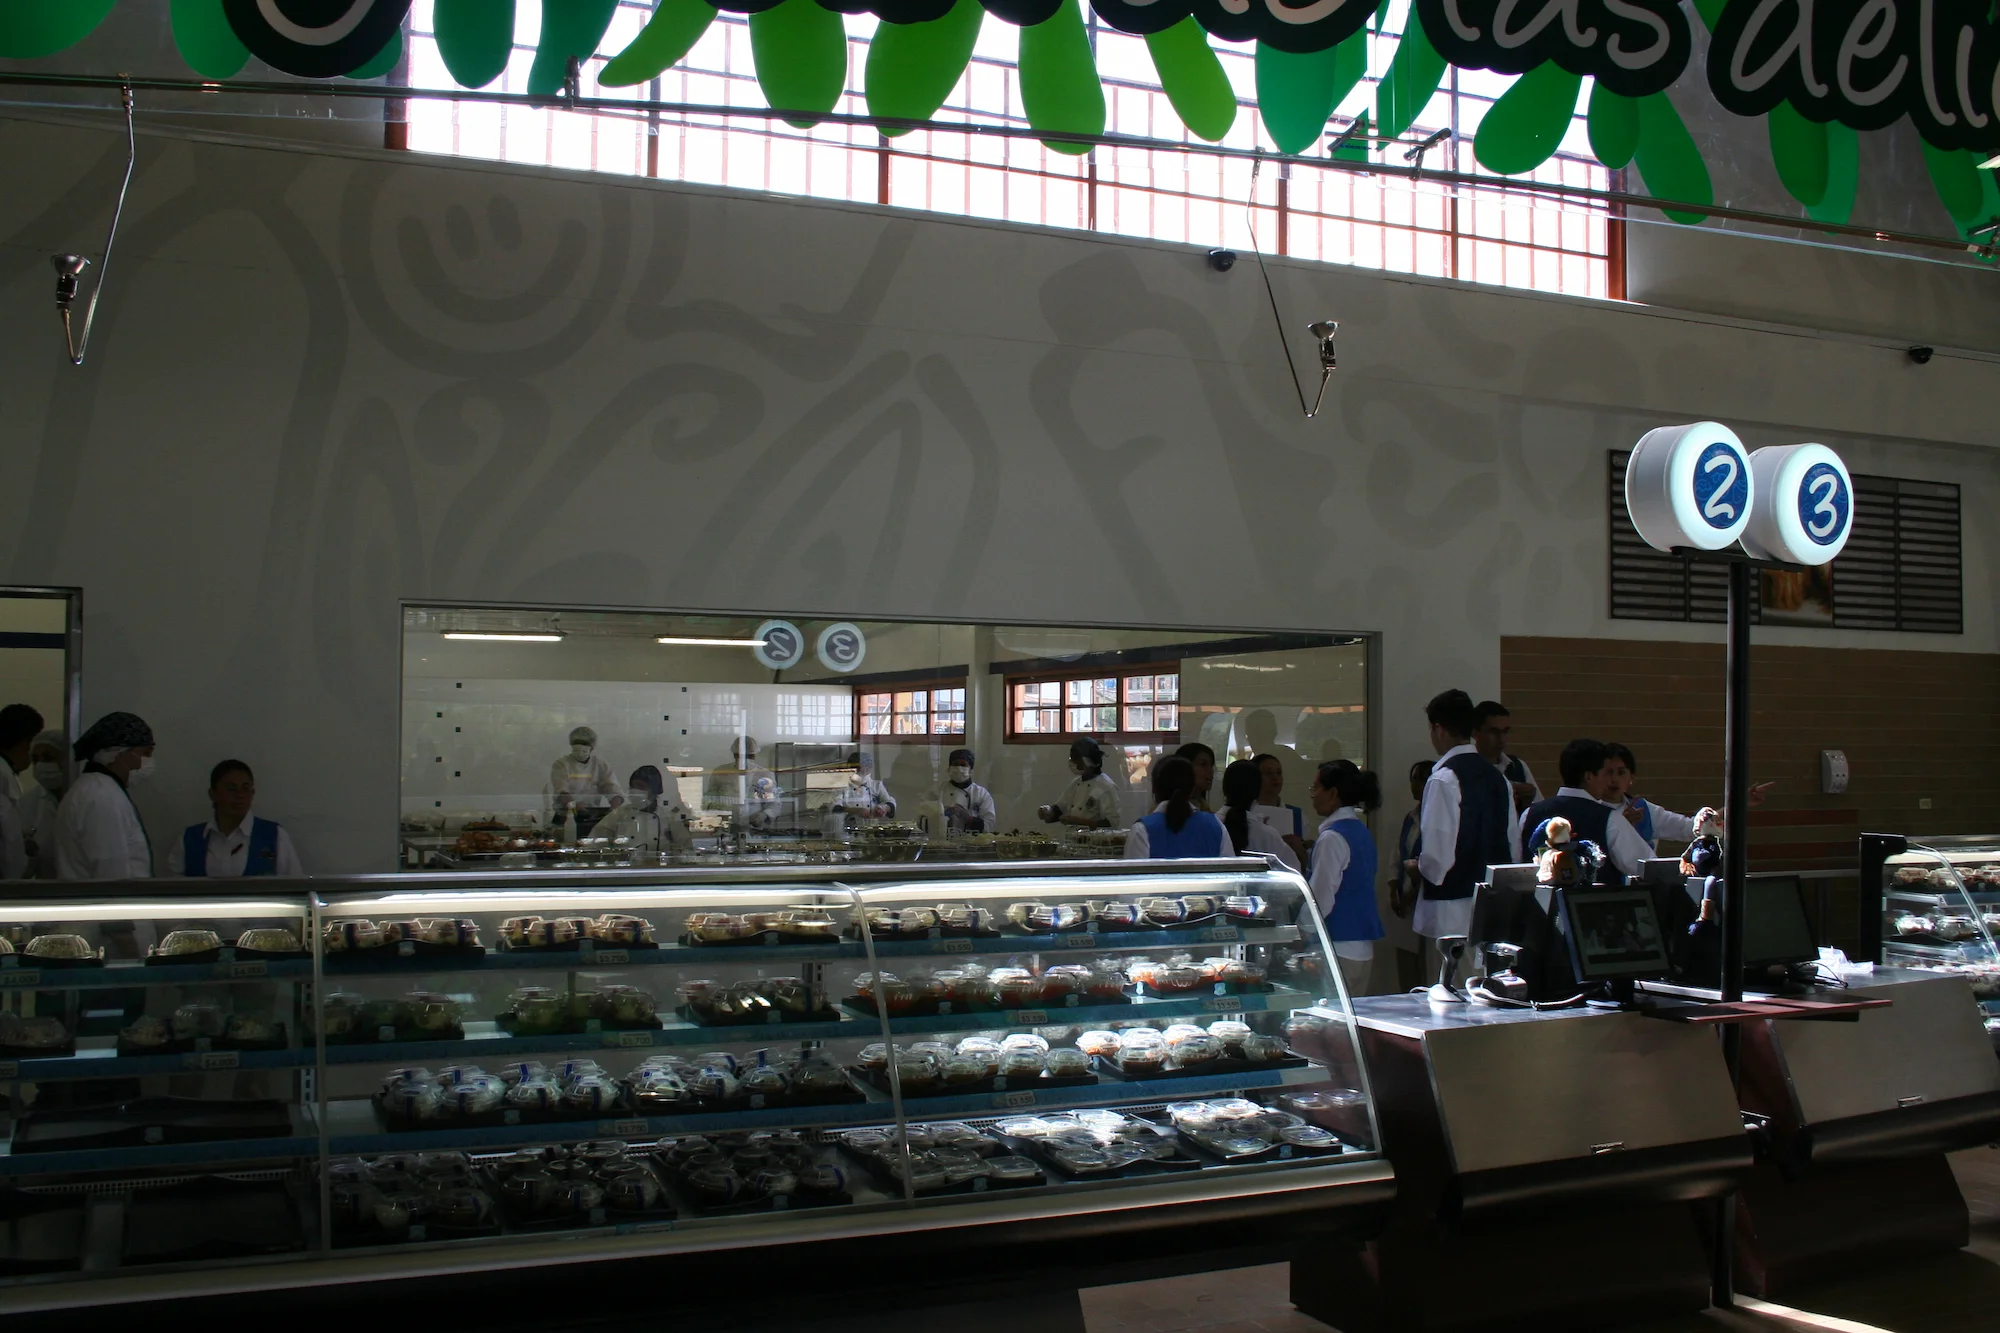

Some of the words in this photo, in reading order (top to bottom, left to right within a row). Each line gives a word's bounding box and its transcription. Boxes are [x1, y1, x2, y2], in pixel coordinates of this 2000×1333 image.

[1444, 0, 1670, 69] as
[1730, 0, 2000, 127] deli
[1705, 455, 1737, 518] 2
[1808, 473, 1837, 537] 3
